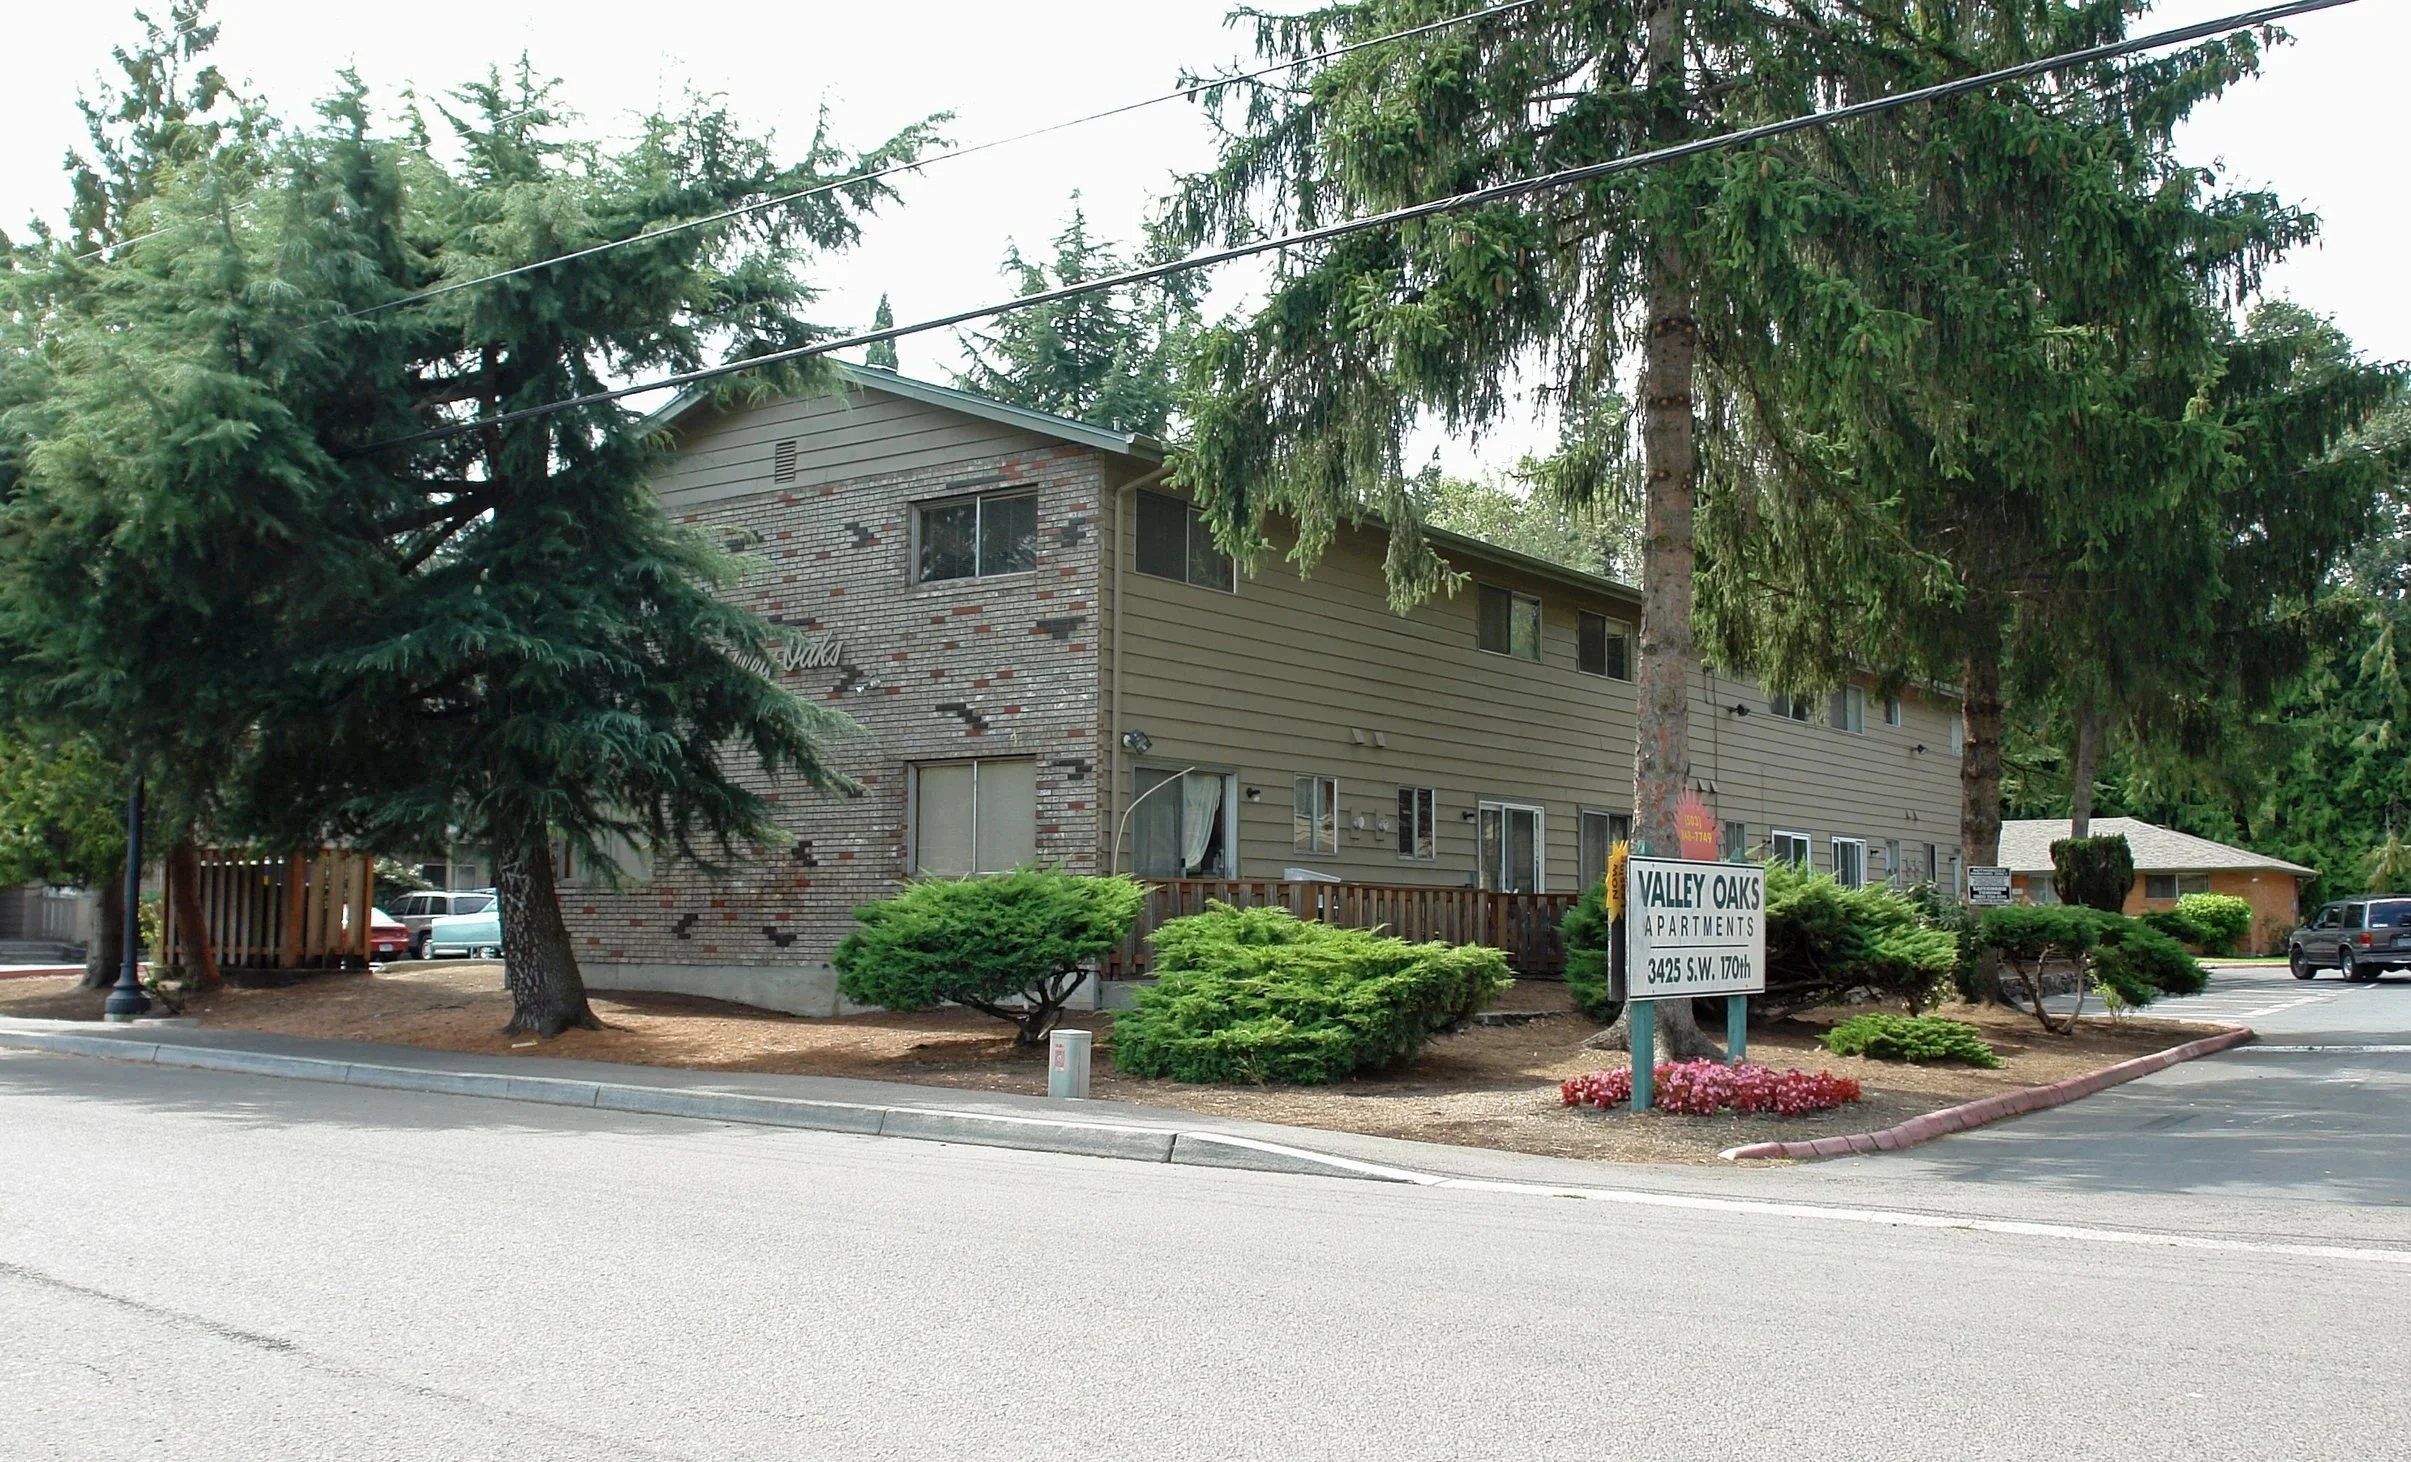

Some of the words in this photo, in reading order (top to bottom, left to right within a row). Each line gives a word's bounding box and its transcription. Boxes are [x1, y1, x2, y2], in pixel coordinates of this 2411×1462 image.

[783, 630, 844, 672] Oaks
[1611, 864, 1619, 900] NOW
[1638, 870, 1706, 909] VALLEY
[1713, 874, 1760, 910] OAKS
[1644, 915, 1754, 937] APARTMENTS
[1648, 957, 1681, 984] 3425
[1687, 956, 1715, 982] S.W.
[1720, 954, 1751, 980] 170th
